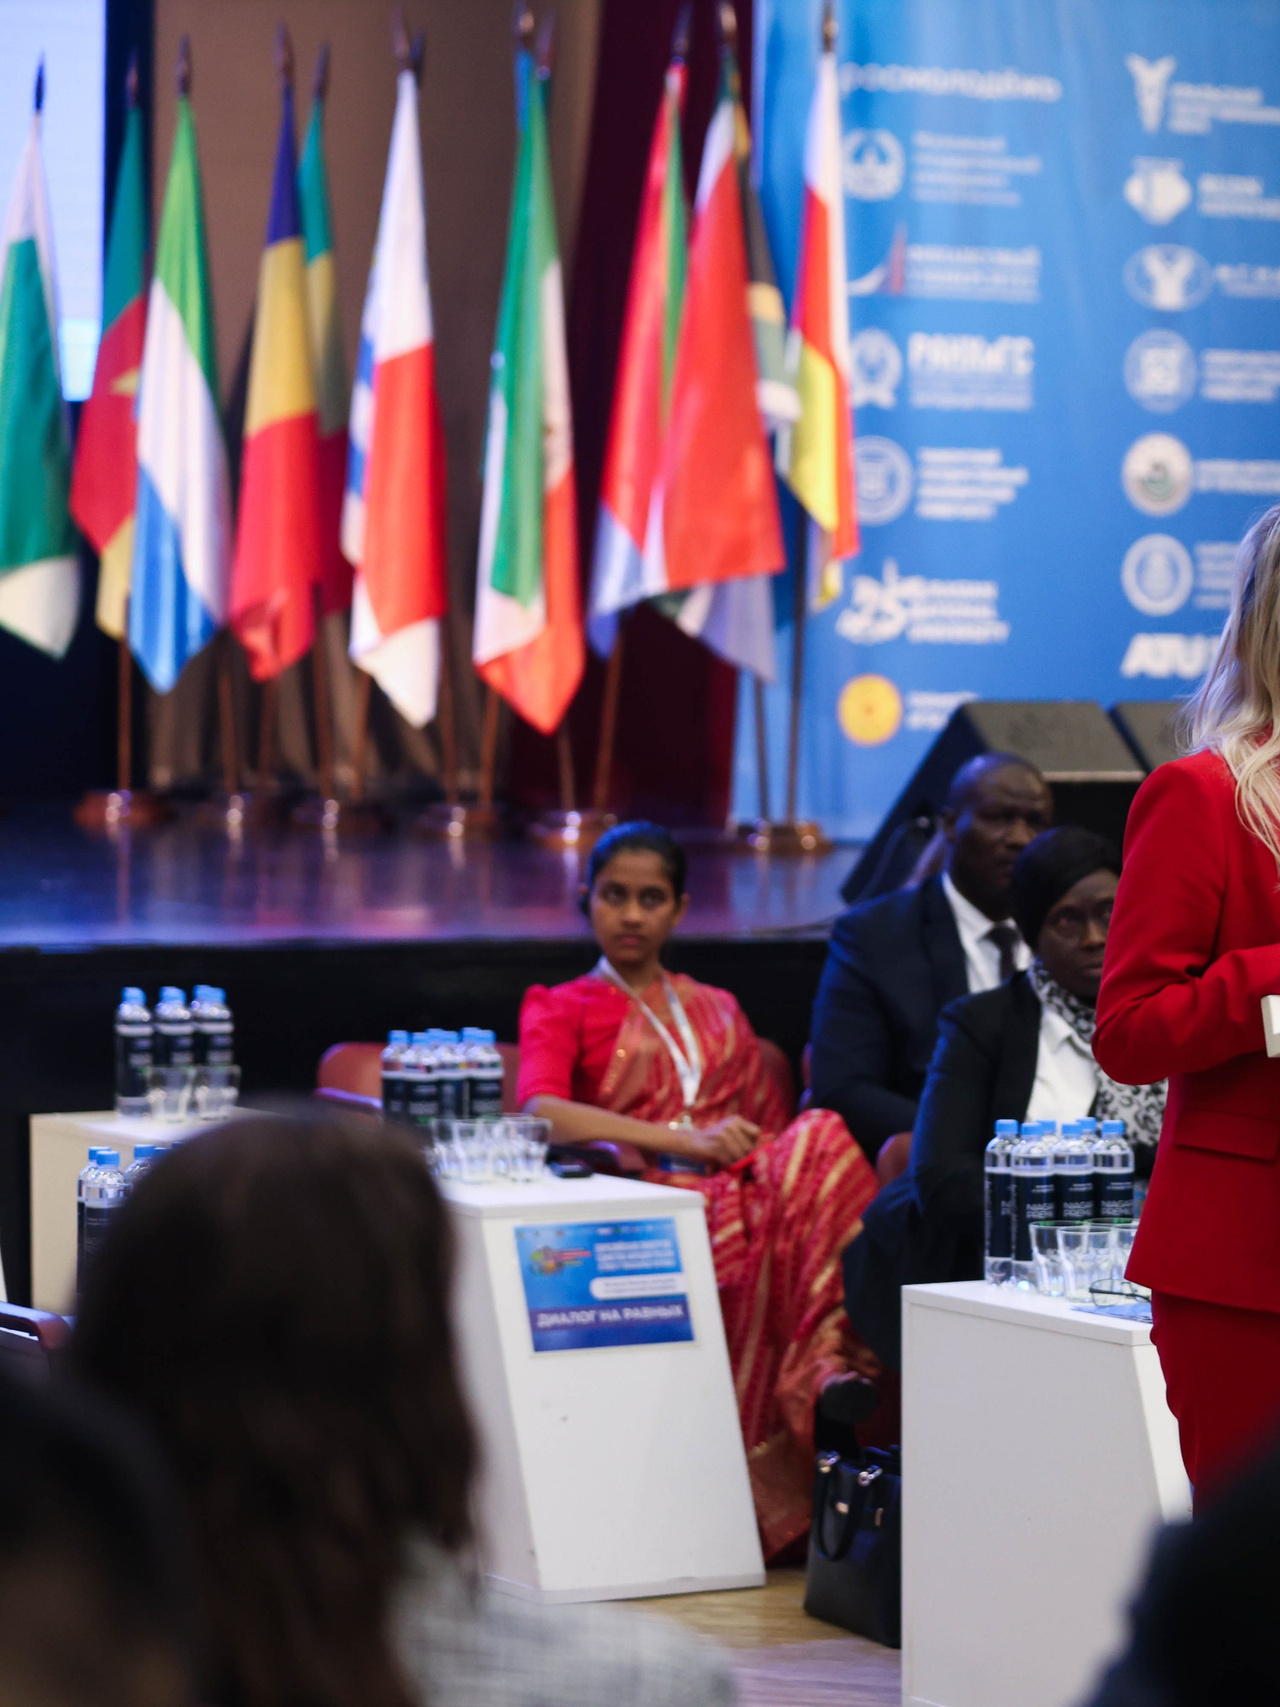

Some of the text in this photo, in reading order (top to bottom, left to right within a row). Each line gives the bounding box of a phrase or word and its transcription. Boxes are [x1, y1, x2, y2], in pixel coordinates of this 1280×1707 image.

[536, 1304, 684, 1329] ДИАЛОГ НА РАВНЫХ
